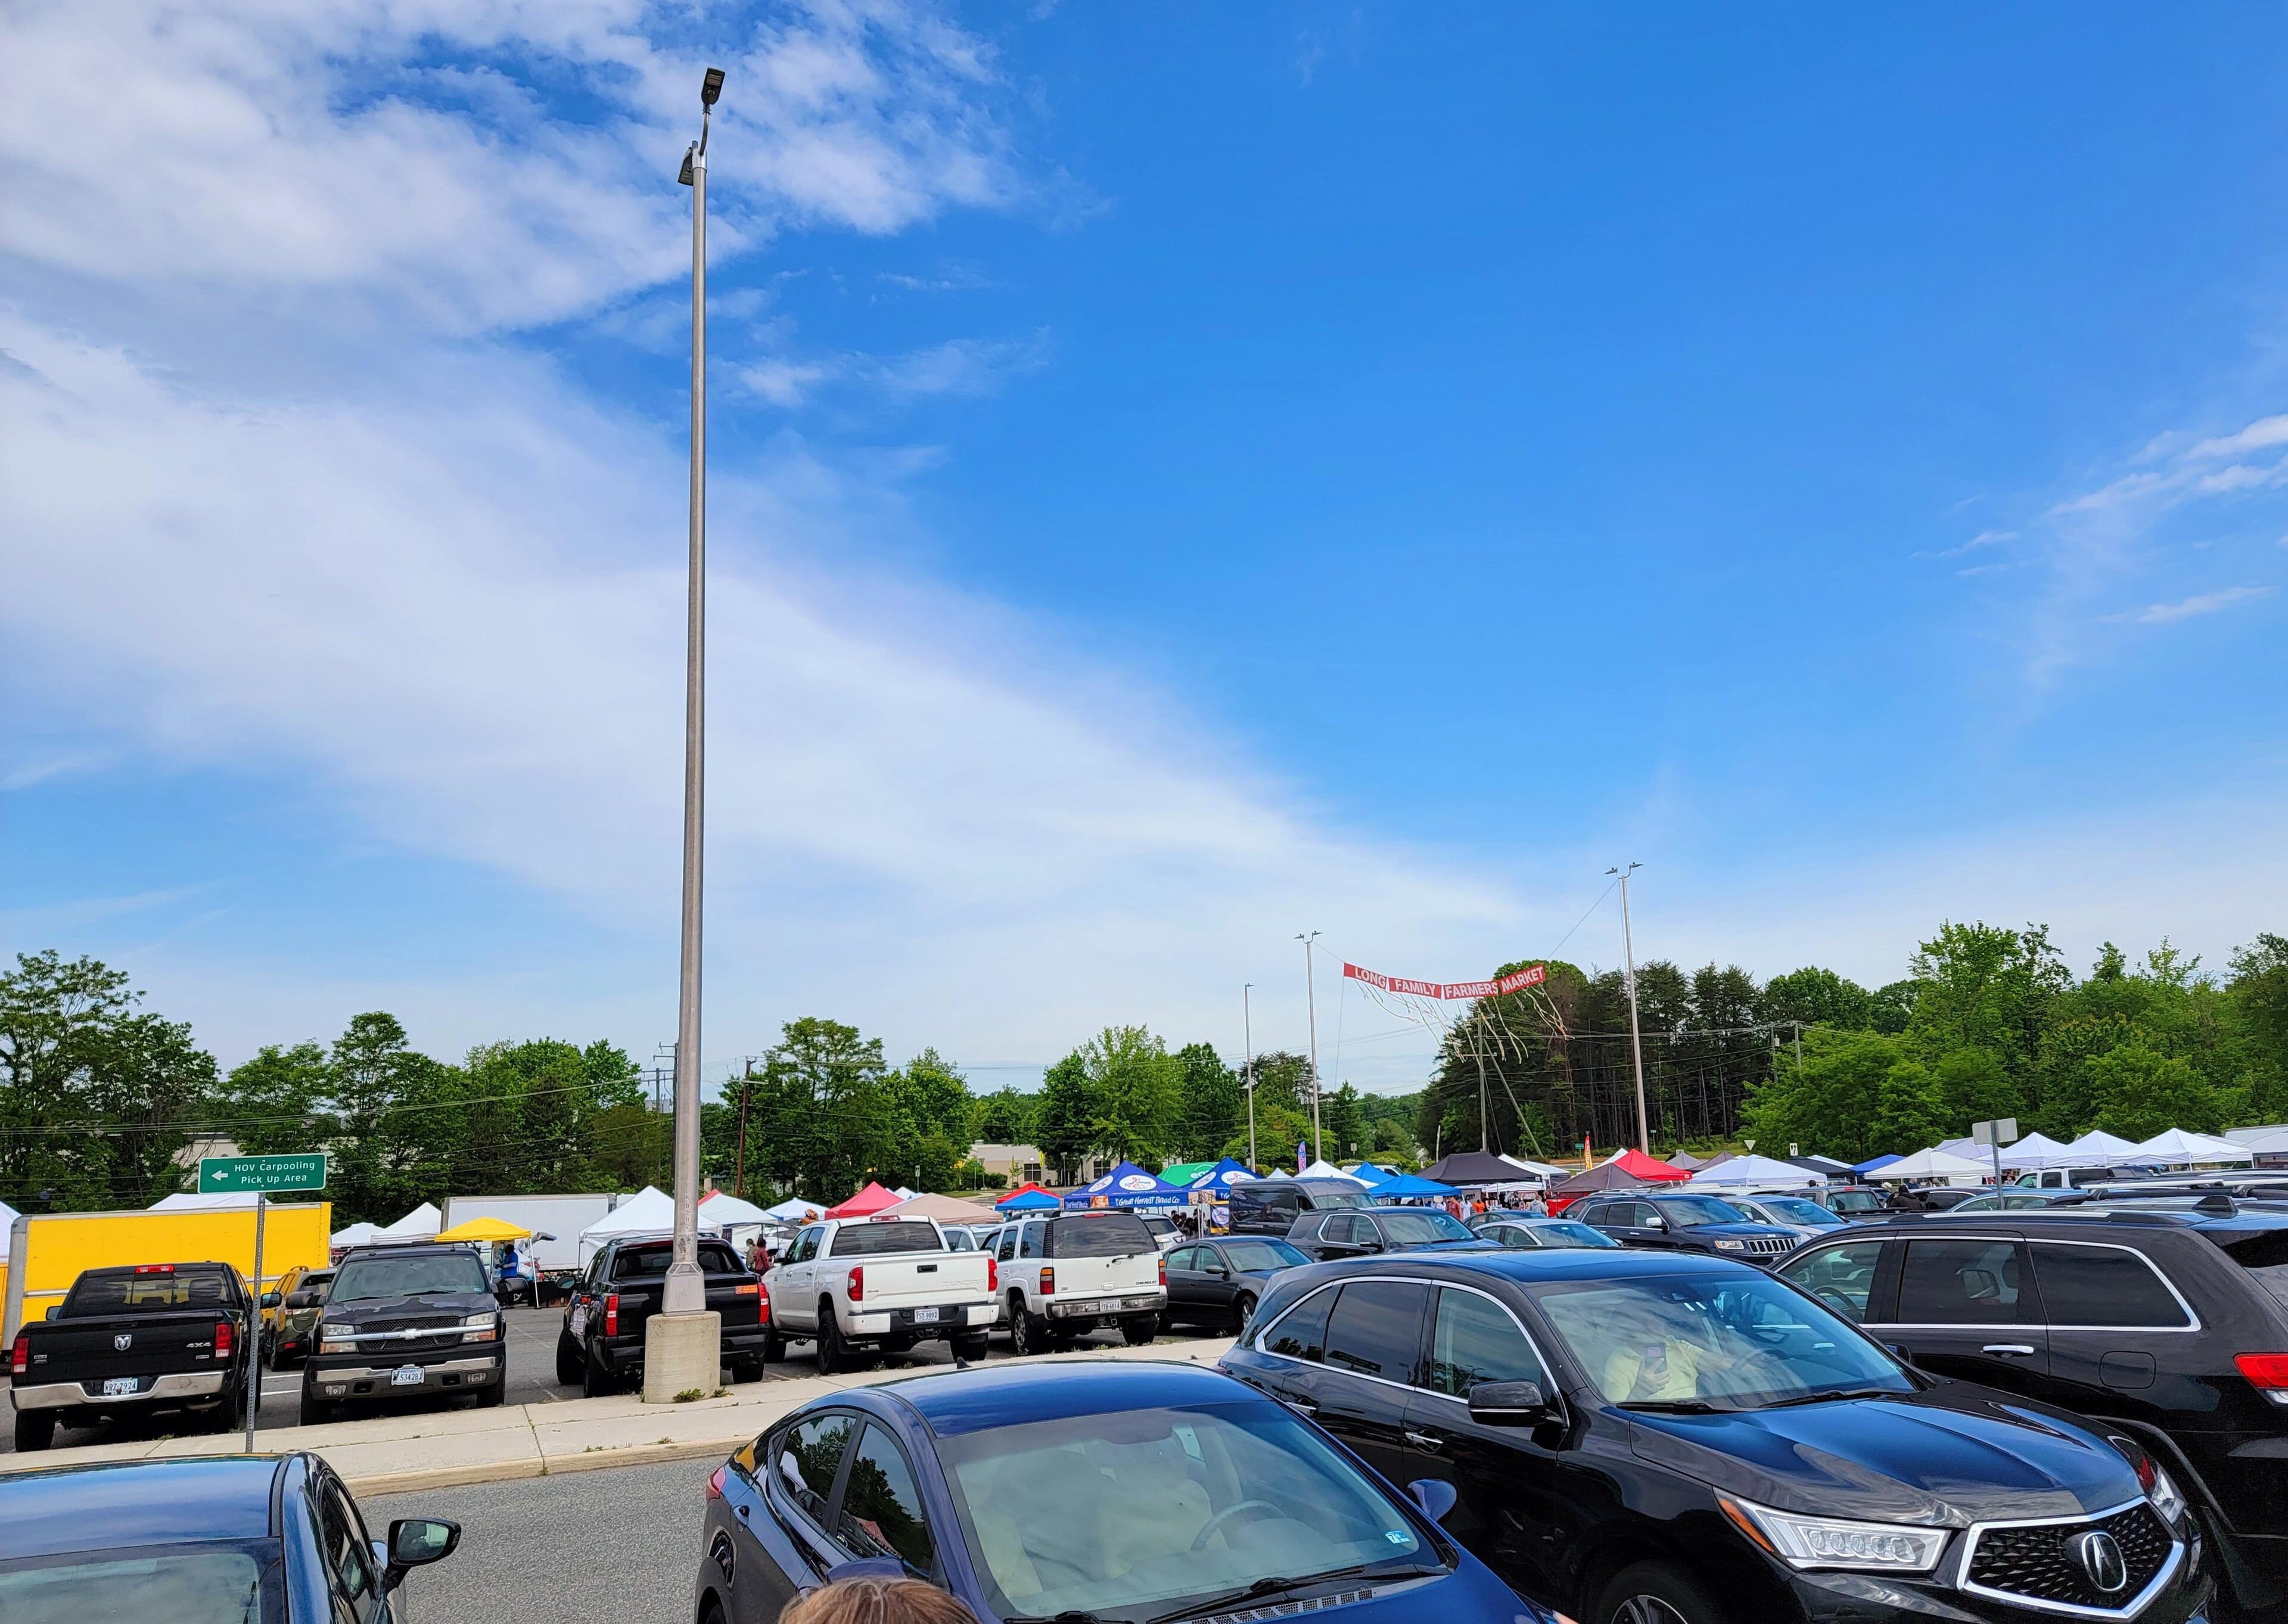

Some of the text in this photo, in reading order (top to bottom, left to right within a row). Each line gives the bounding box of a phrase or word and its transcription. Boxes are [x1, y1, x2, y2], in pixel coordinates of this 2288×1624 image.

[1355, 966, 1544, 998] LONG FAMILY FARMERS MARKET
[235, 1162, 315, 1172] HOV Carpooling
[241, 1175, 262, 1184] Pick
[267, 1175, 279, 1184] Up
[942, 1279, 986, 1287] TUNDRA
